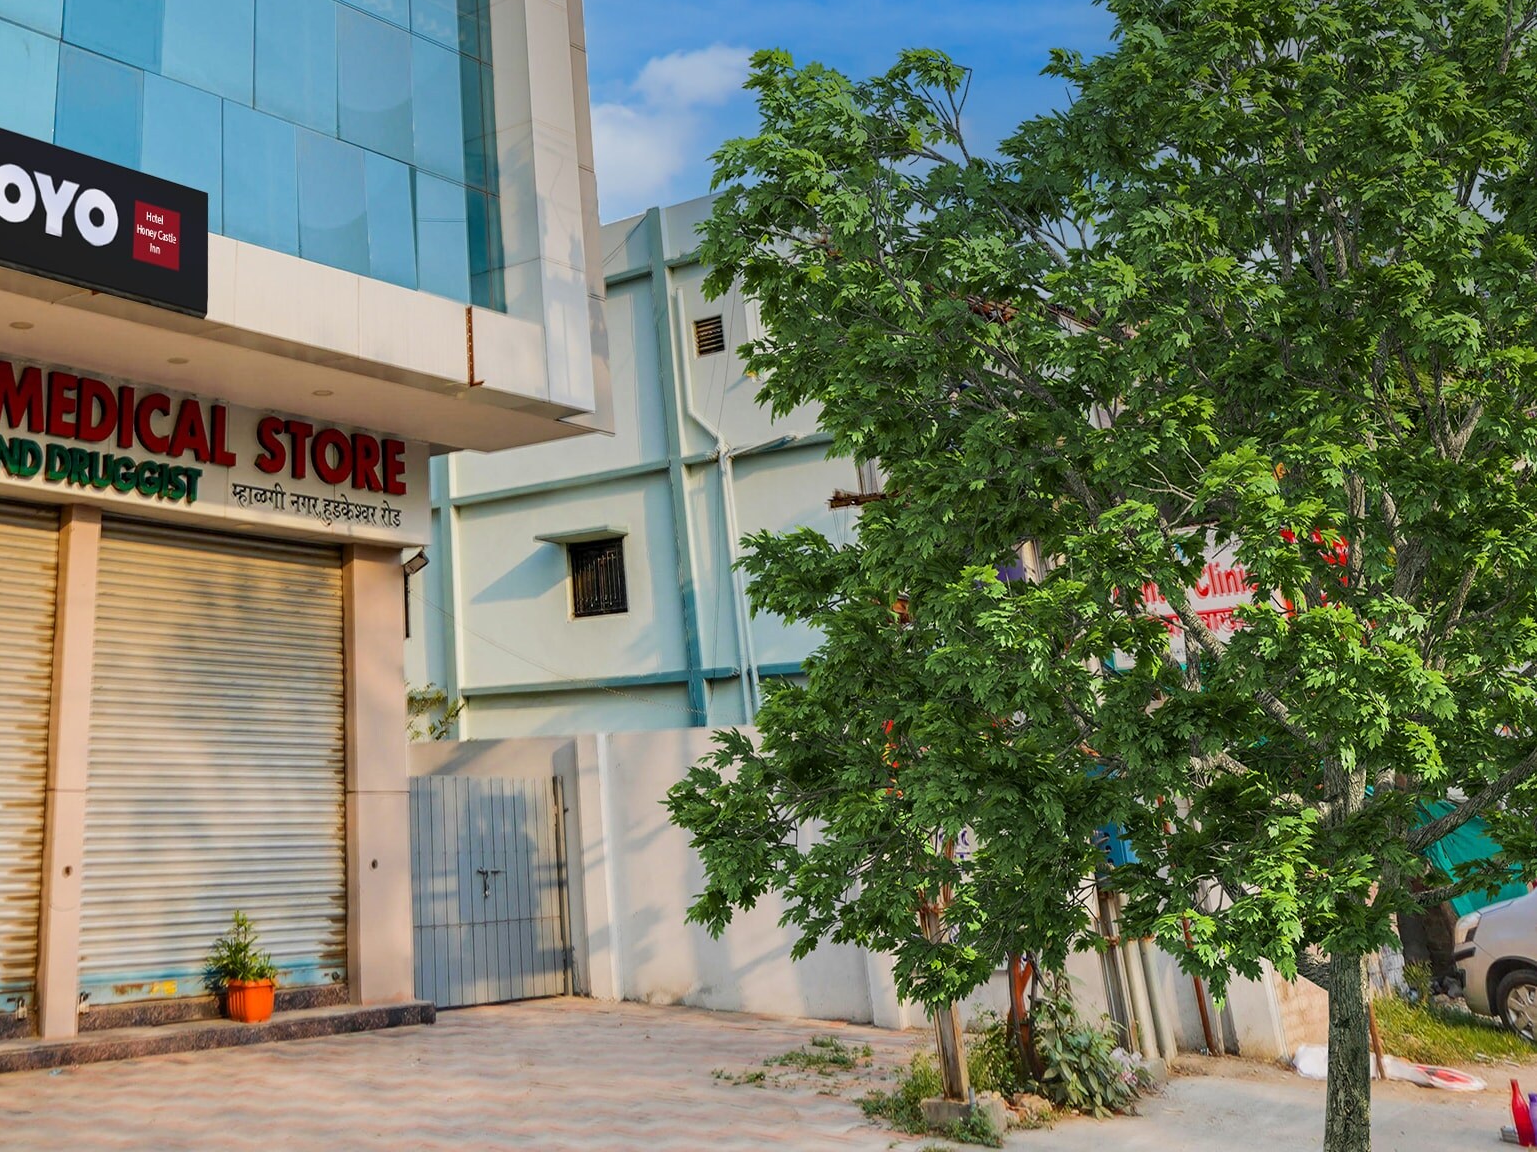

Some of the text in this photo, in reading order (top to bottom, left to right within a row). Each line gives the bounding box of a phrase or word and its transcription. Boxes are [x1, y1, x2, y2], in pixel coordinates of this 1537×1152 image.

[145, 211, 164, 225] Hotel
[136, 224, 177, 244] Honey Castle
[149, 243, 161, 255] Inn
[255, 417, 407, 495] STORE
[44, 445, 203, 504] DRUGGIST
[380, 499, 403, 528] रोड
